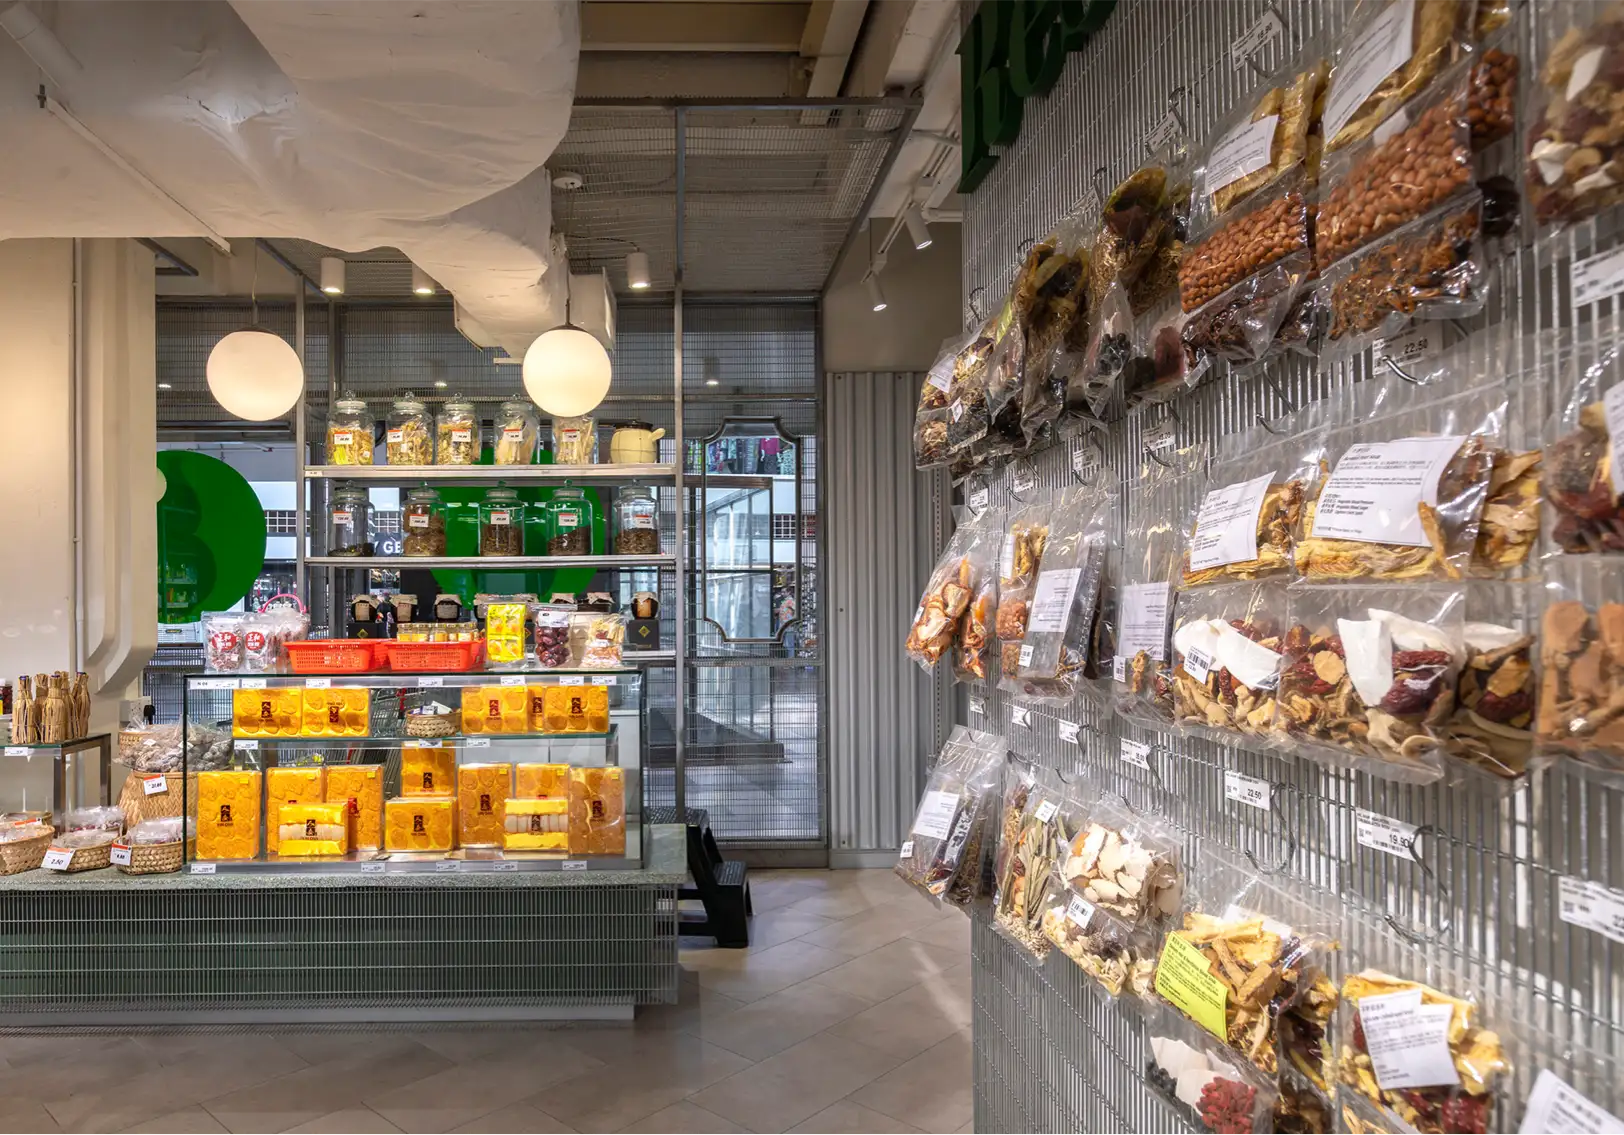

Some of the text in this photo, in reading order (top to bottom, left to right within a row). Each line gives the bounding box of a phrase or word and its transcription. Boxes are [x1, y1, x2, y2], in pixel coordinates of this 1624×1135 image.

[1404, 338, 1428, 354] 22.50
[1247, 788, 1262, 800] 22.50
[1389, 834, 1410, 849] 19.90
